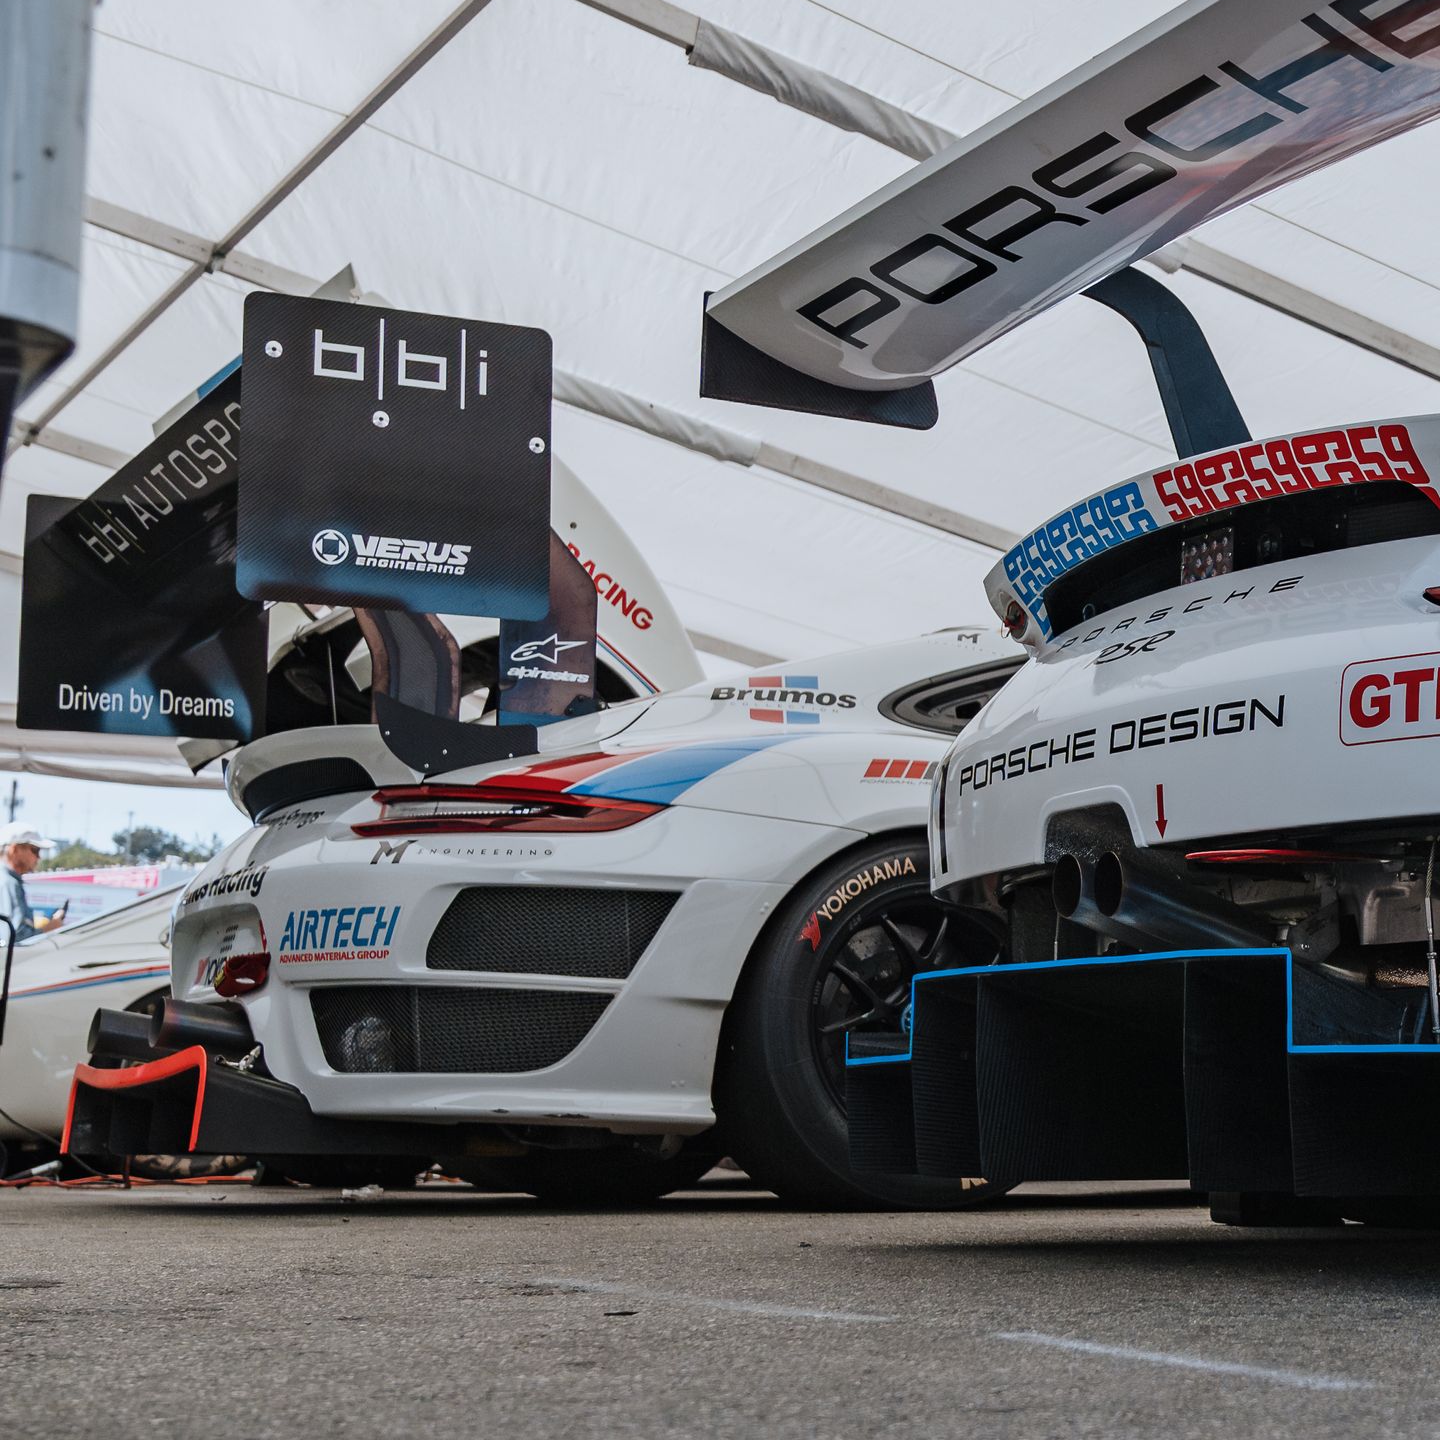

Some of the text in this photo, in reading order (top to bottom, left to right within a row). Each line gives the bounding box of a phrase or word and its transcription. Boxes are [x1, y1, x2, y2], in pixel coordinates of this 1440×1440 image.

[351, 533, 472, 566] VERUS
[355, 556, 465, 576] ENGINEERING
[1057, 575, 1304, 653] PORSCHE
[507, 665, 589, 684] alpinestars
[58, 683, 235, 720] Driven by Dreams
[710, 687, 857, 709] Brumos
[959, 694, 1286, 797] PORSCHE DESIGN
[417, 847, 553, 857] ENGINEERING
[817, 856, 917, 922] YOKOHAMA
[279, 906, 402, 952] AIRTECH
[280, 950, 390, 964] ADVANCED MATERIALS GROUP
